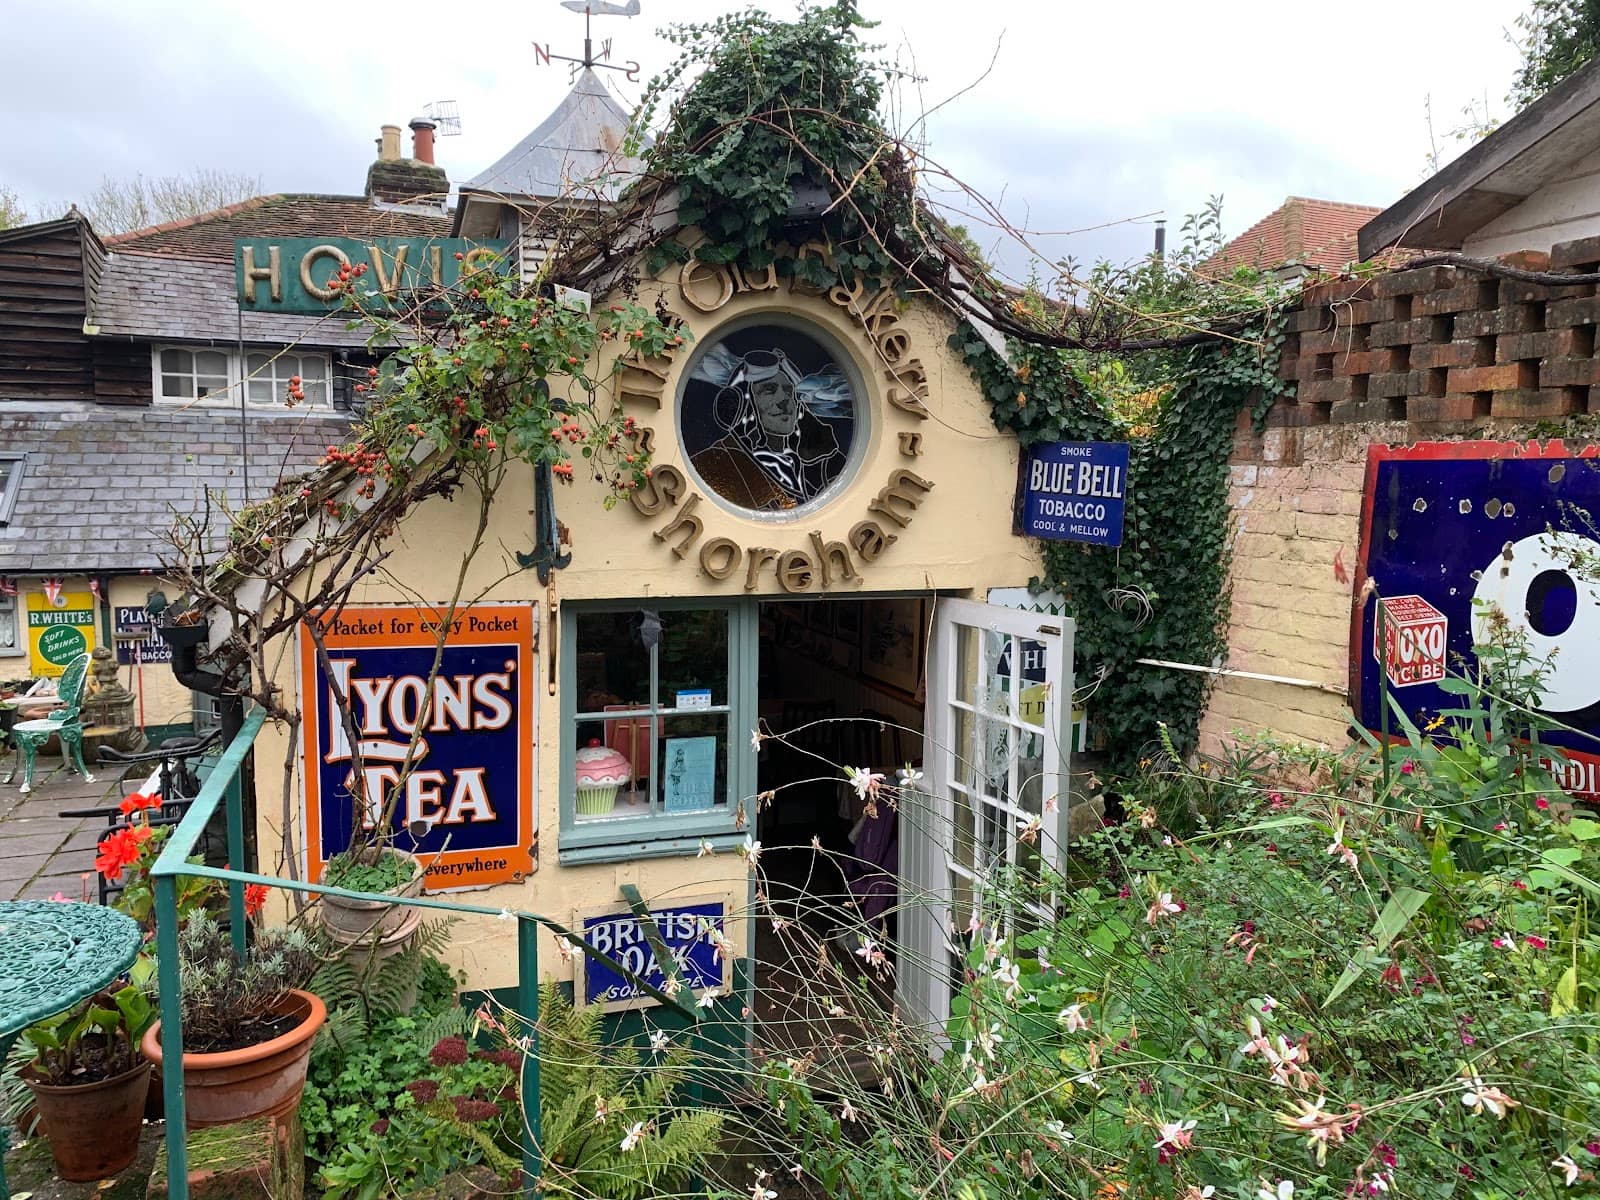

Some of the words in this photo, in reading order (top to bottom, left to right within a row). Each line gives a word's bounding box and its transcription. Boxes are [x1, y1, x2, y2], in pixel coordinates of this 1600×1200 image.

[531, 41, 550, 66] N
[601, 37, 612, 62] W
[1061, 446, 1093, 457] SMOKE
[1030, 459, 1075, 494] BLUE
[1077, 461, 1122, 498] BELL
[1039, 499, 1106, 521] TOBACCO
[629, 463, 936, 593] Shoreham
[1033, 520, 1057, 531] COOL
[1059, 523, 1066, 532] &
[1070, 524, 1109, 538] MELLOW
[44, 630, 65, 643] SOFT
[333, 618, 384, 637] Packet
[390, 618, 415, 634] for
[469, 616, 519, 632] Pocket
[47, 635, 80, 653] DRINKS
[1400, 624, 1444, 664] OXO
[343, 766, 497, 830] TEA
[425, 857, 507, 877] everywhere
